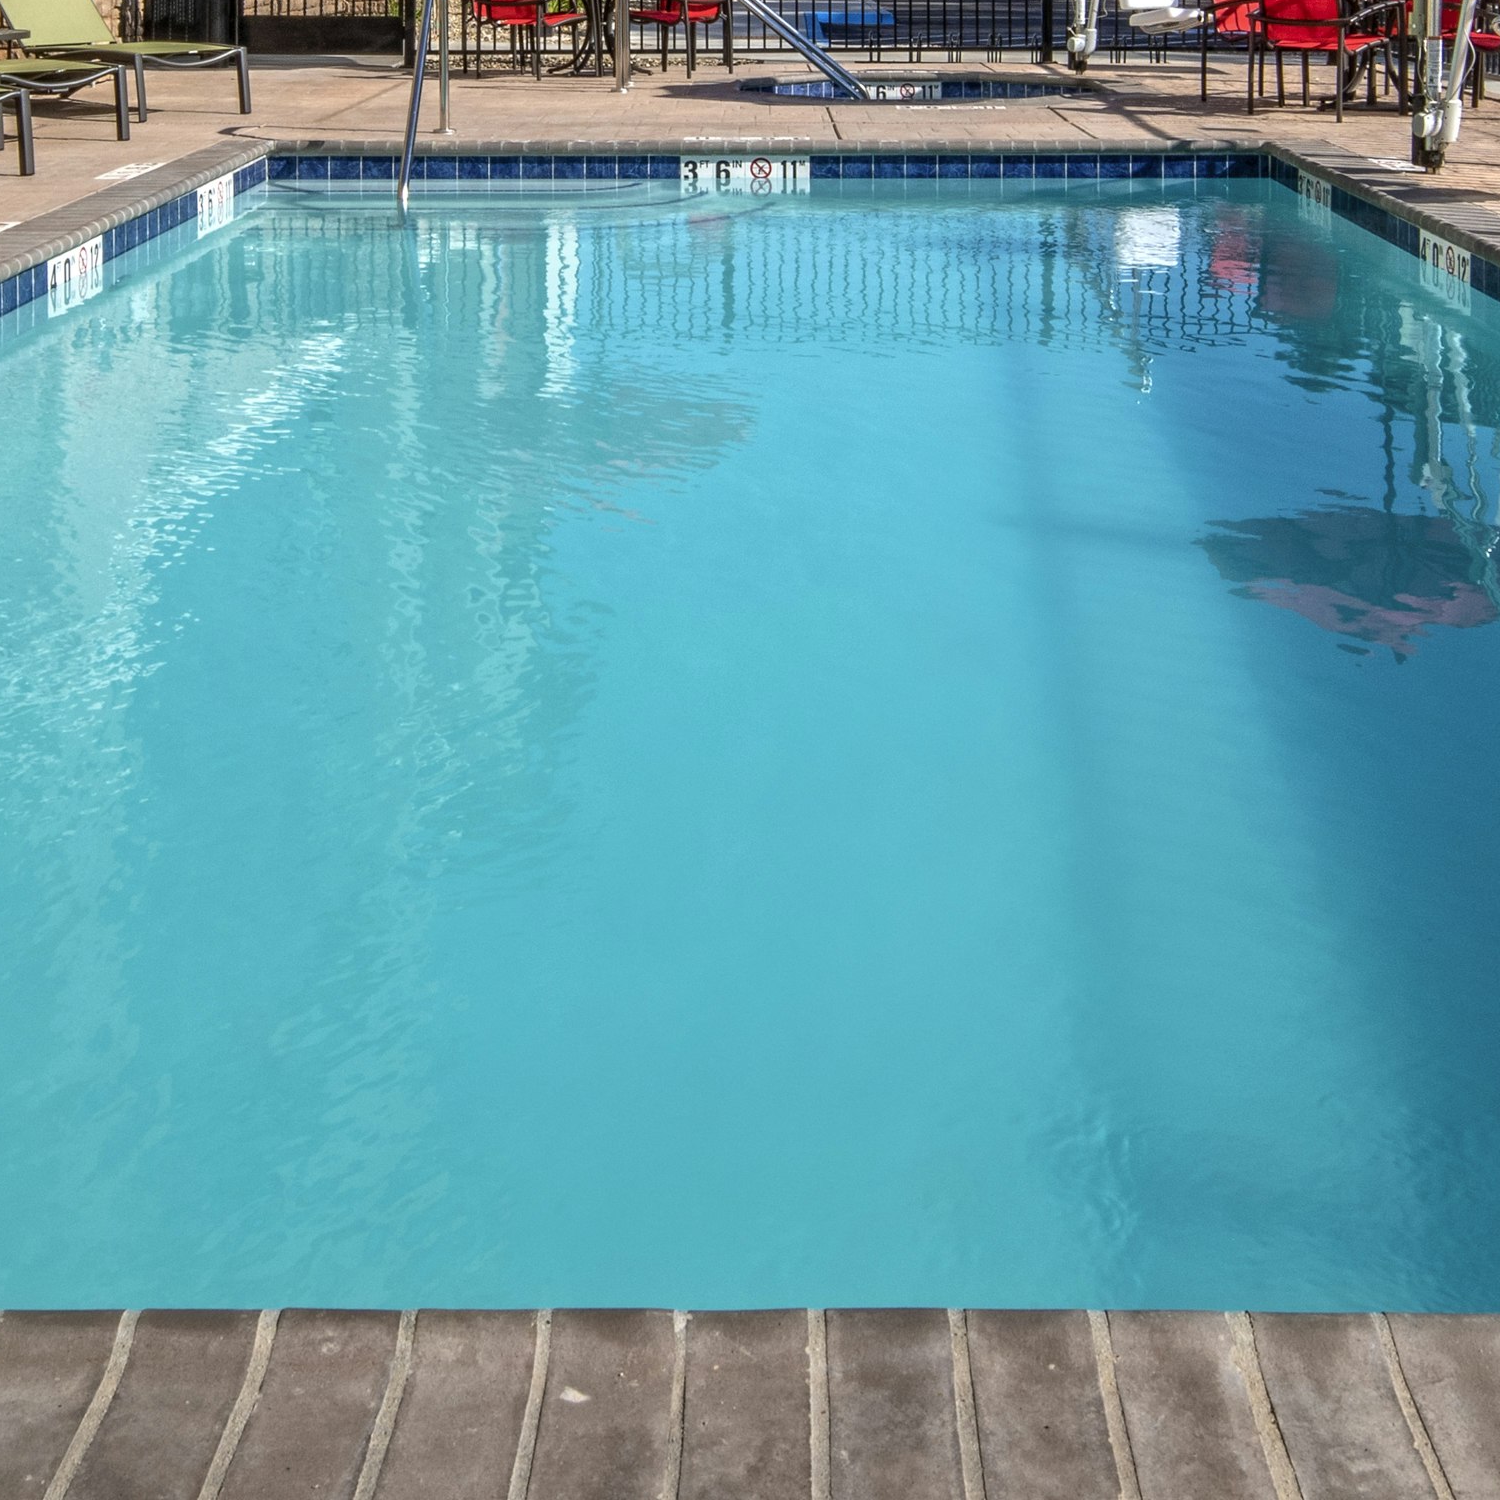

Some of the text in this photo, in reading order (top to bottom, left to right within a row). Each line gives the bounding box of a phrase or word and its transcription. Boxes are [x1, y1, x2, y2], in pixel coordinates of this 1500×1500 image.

[876, 85, 887, 100] 6
[684, 160, 698, 179] 3
[700, 160, 709, 168] FT
[716, 160, 730, 179] 6
[733, 160, 742, 168] IN
[1421, 237, 1427, 261] 4
[1432, 242, 1439, 268] 0
[50, 264, 57, 289] 4
[64, 258, 71, 283] 0
